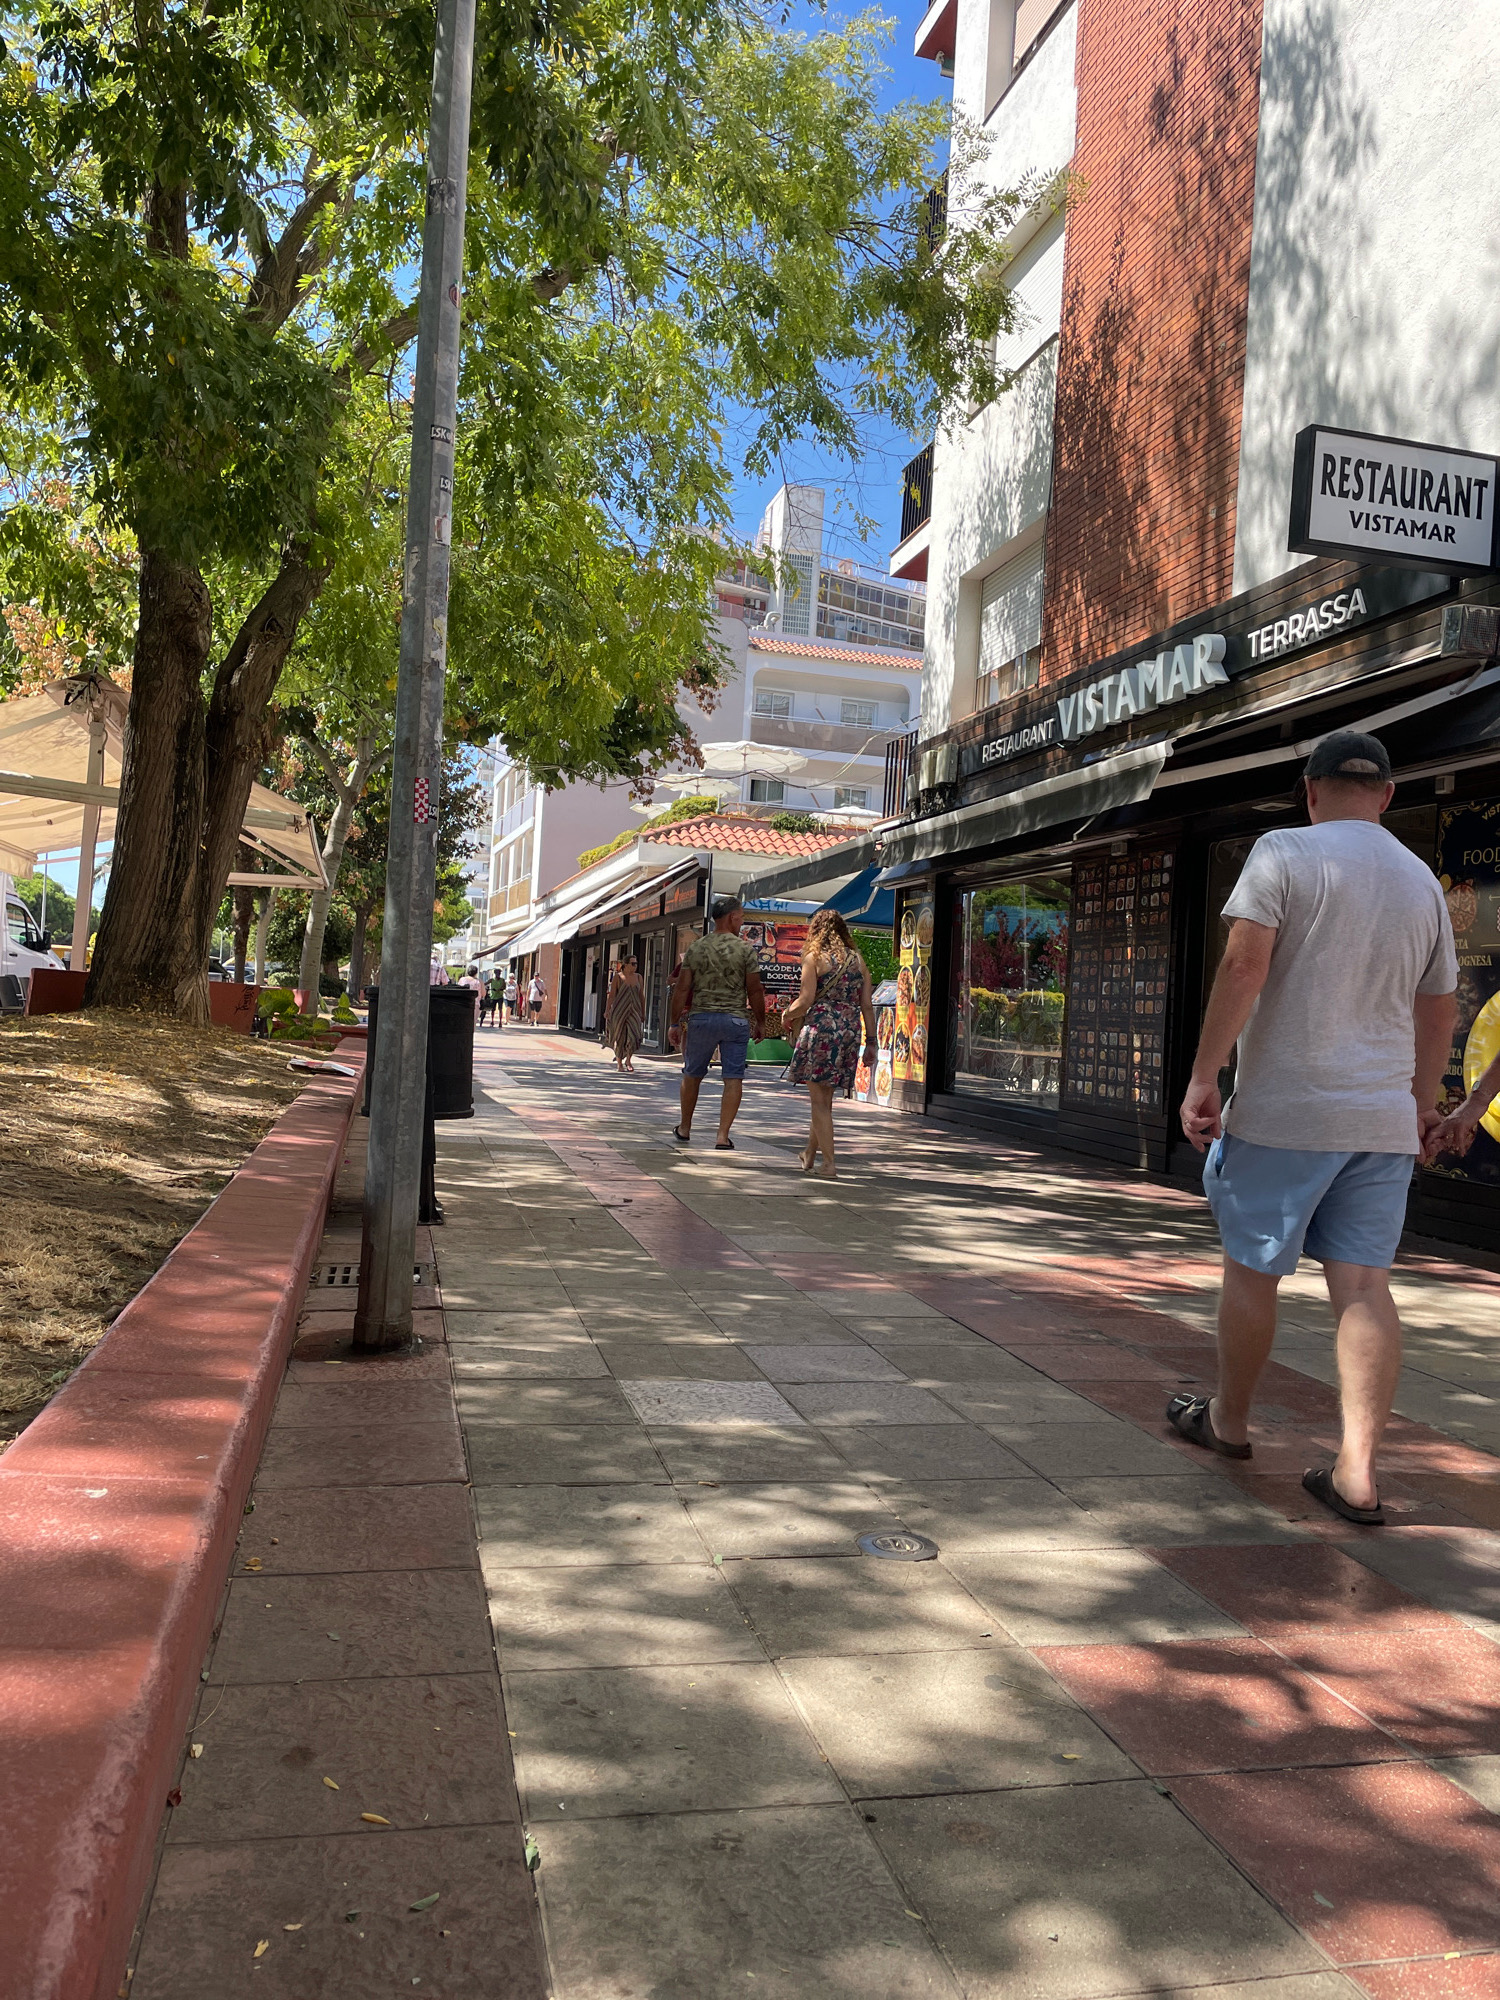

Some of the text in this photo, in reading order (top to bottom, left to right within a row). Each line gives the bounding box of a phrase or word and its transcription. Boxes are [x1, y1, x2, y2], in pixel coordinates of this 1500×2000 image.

[1320, 453, 1489, 520] RESTAURANT
[1349, 510, 1457, 544] VISTAMAR
[982, 588, 1368, 763] RESTAURANT VISTAMAR TERRASSA
[767, 972, 798, 981] BODEGA
[1458, 954, 1492, 967] OGNESA
